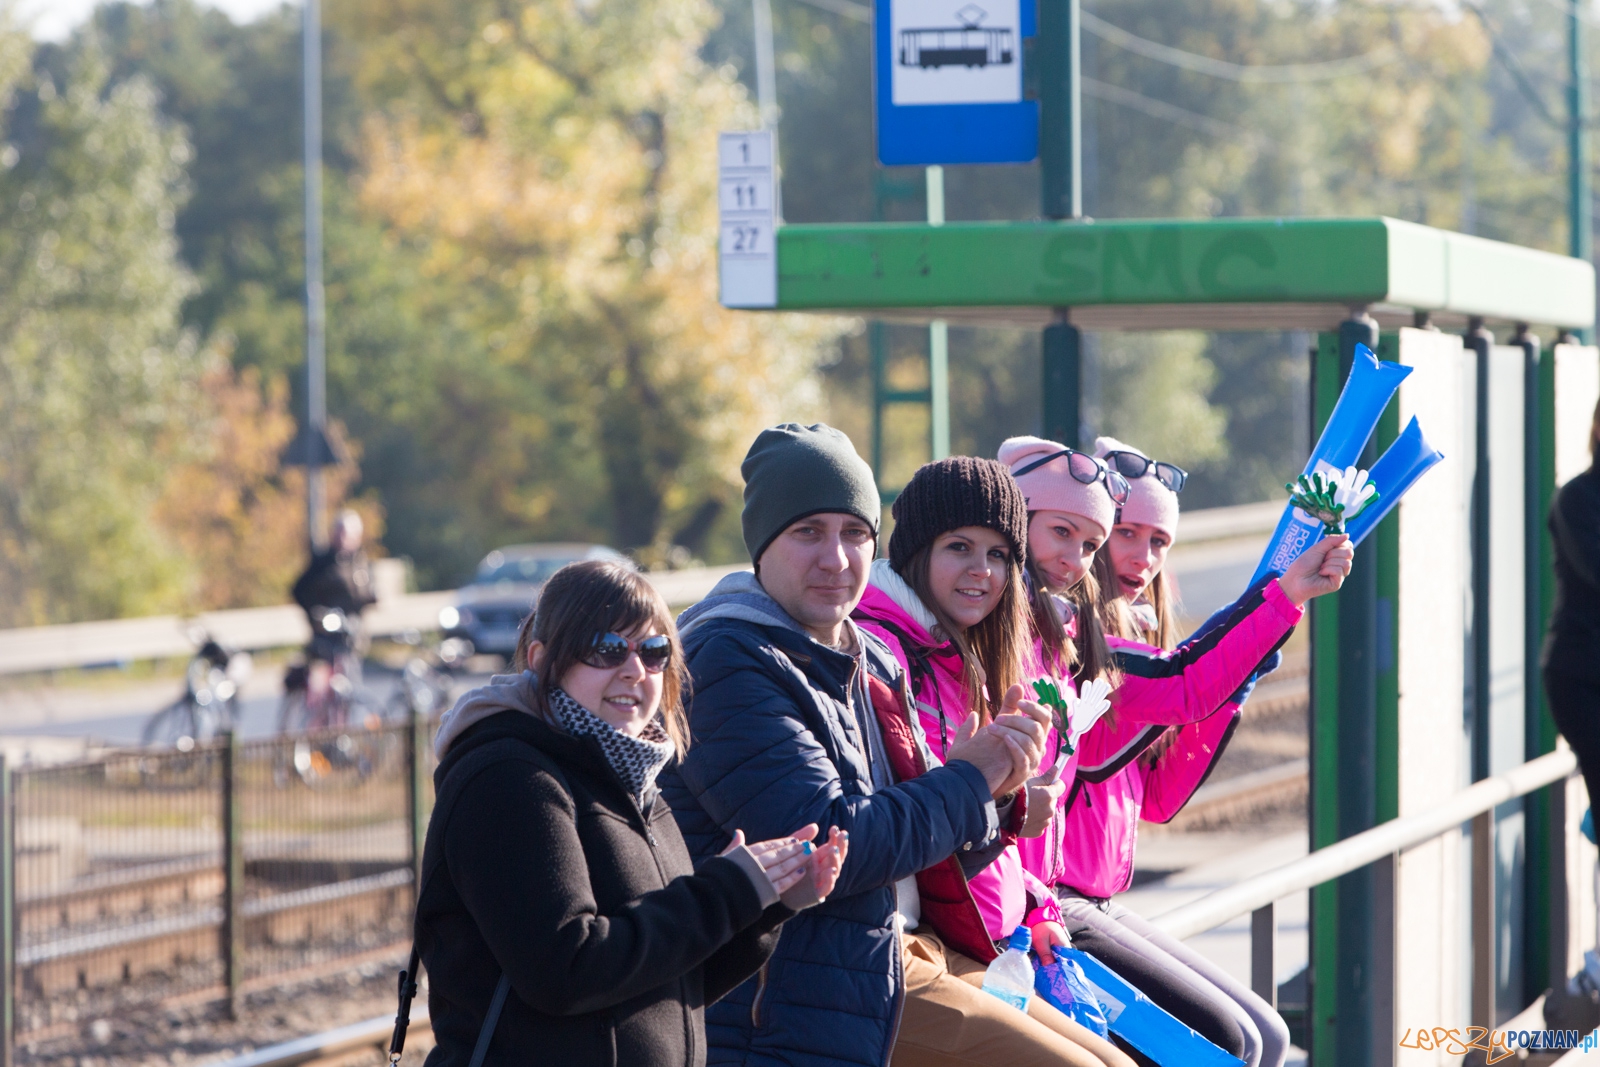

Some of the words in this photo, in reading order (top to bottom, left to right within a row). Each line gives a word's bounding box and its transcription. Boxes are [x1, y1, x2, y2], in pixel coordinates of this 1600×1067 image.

[738, 142, 749, 164] 1
[733, 184, 756, 207] 11
[732, 226, 760, 250] 27
